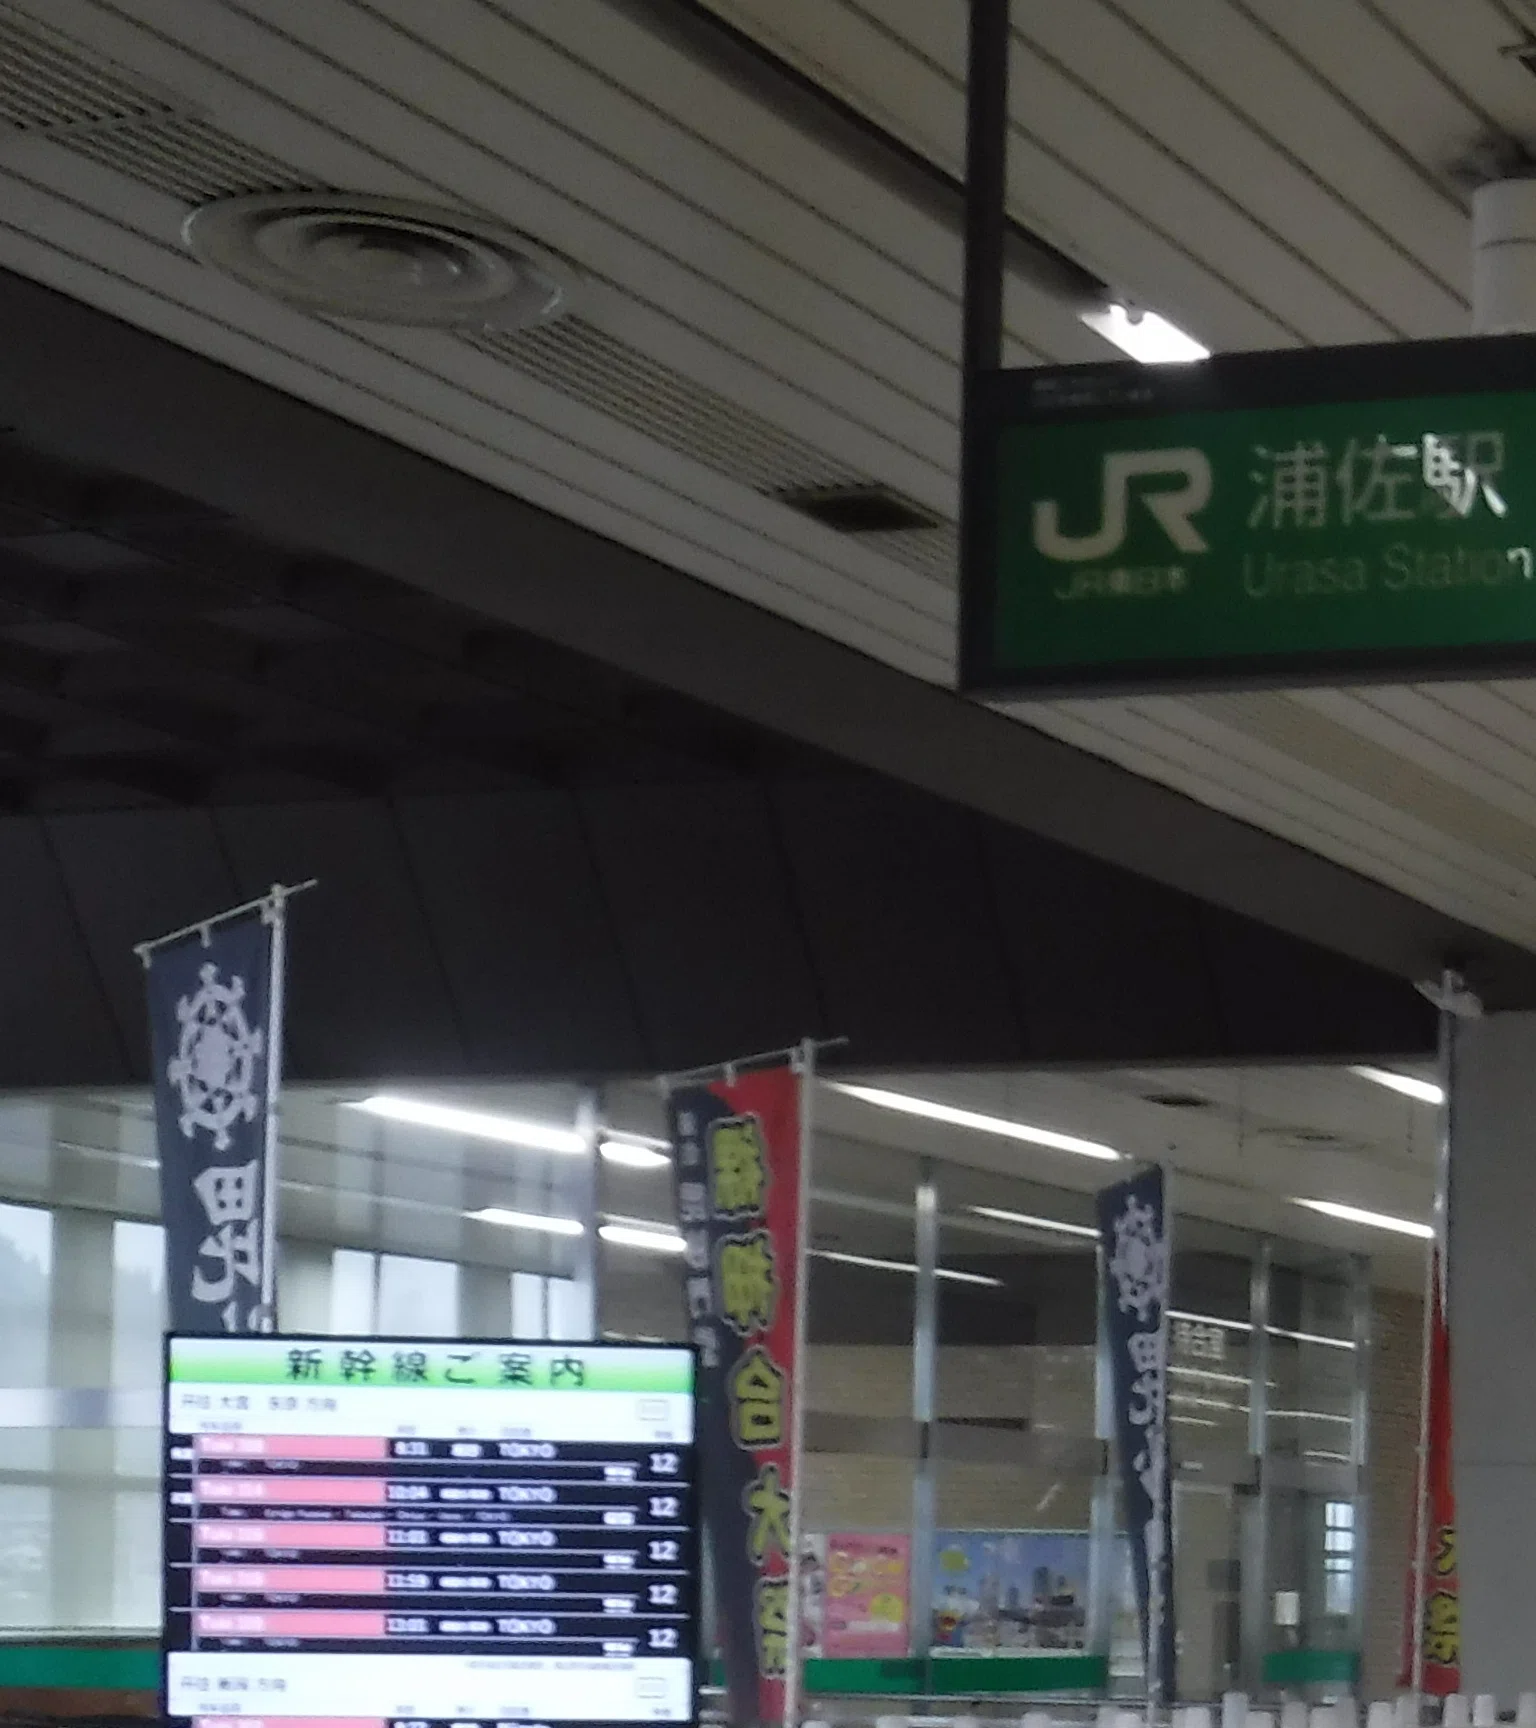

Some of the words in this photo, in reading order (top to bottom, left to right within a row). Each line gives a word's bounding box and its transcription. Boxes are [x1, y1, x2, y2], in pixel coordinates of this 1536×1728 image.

[1032, 446, 1213, 561] JR
[1246, 430, 1510, 528] 浦佐駅
[1242, 551, 1368, 599] Urasa
[1383, 541, 1535, 592] Station
[284, 1348, 588, 1388] 新幹線ご案内
